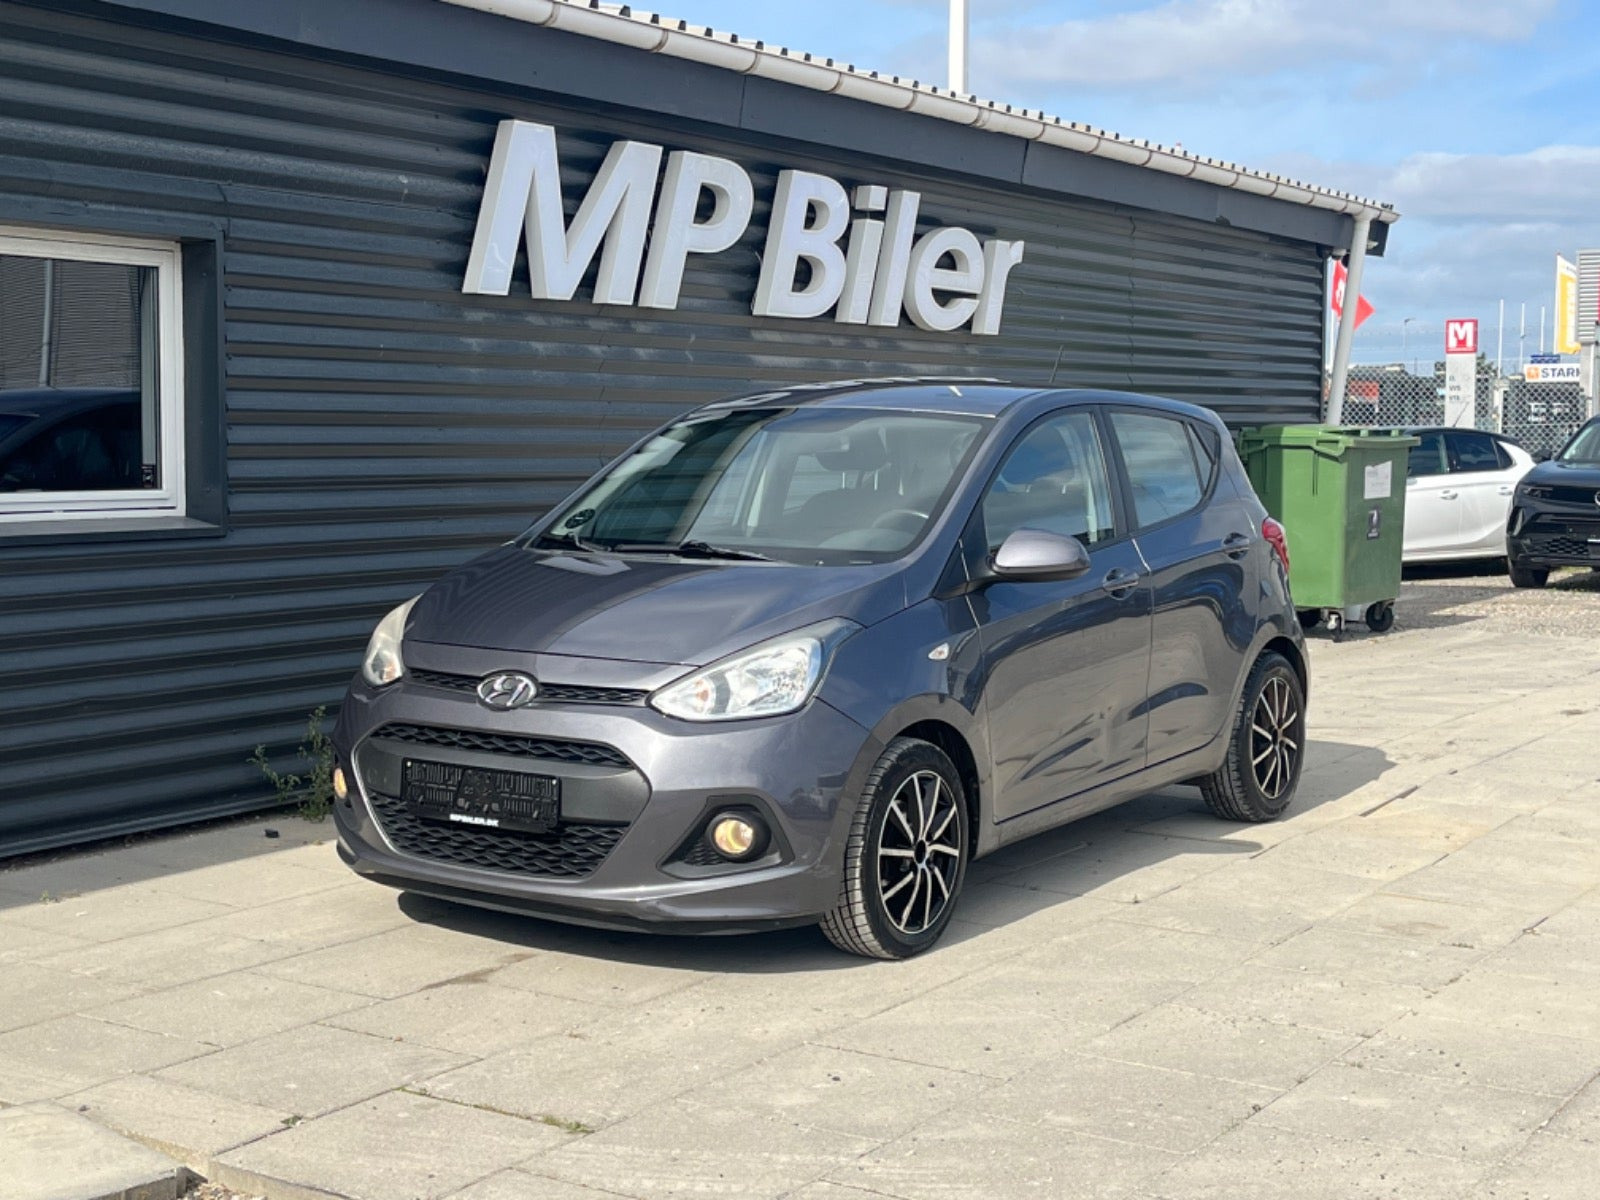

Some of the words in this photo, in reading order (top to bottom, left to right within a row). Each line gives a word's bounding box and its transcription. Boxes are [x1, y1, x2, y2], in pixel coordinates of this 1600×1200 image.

[462, 119, 754, 309] MP
[752, 169, 1025, 336] Biler
[1448, 321, 1474, 348] M
